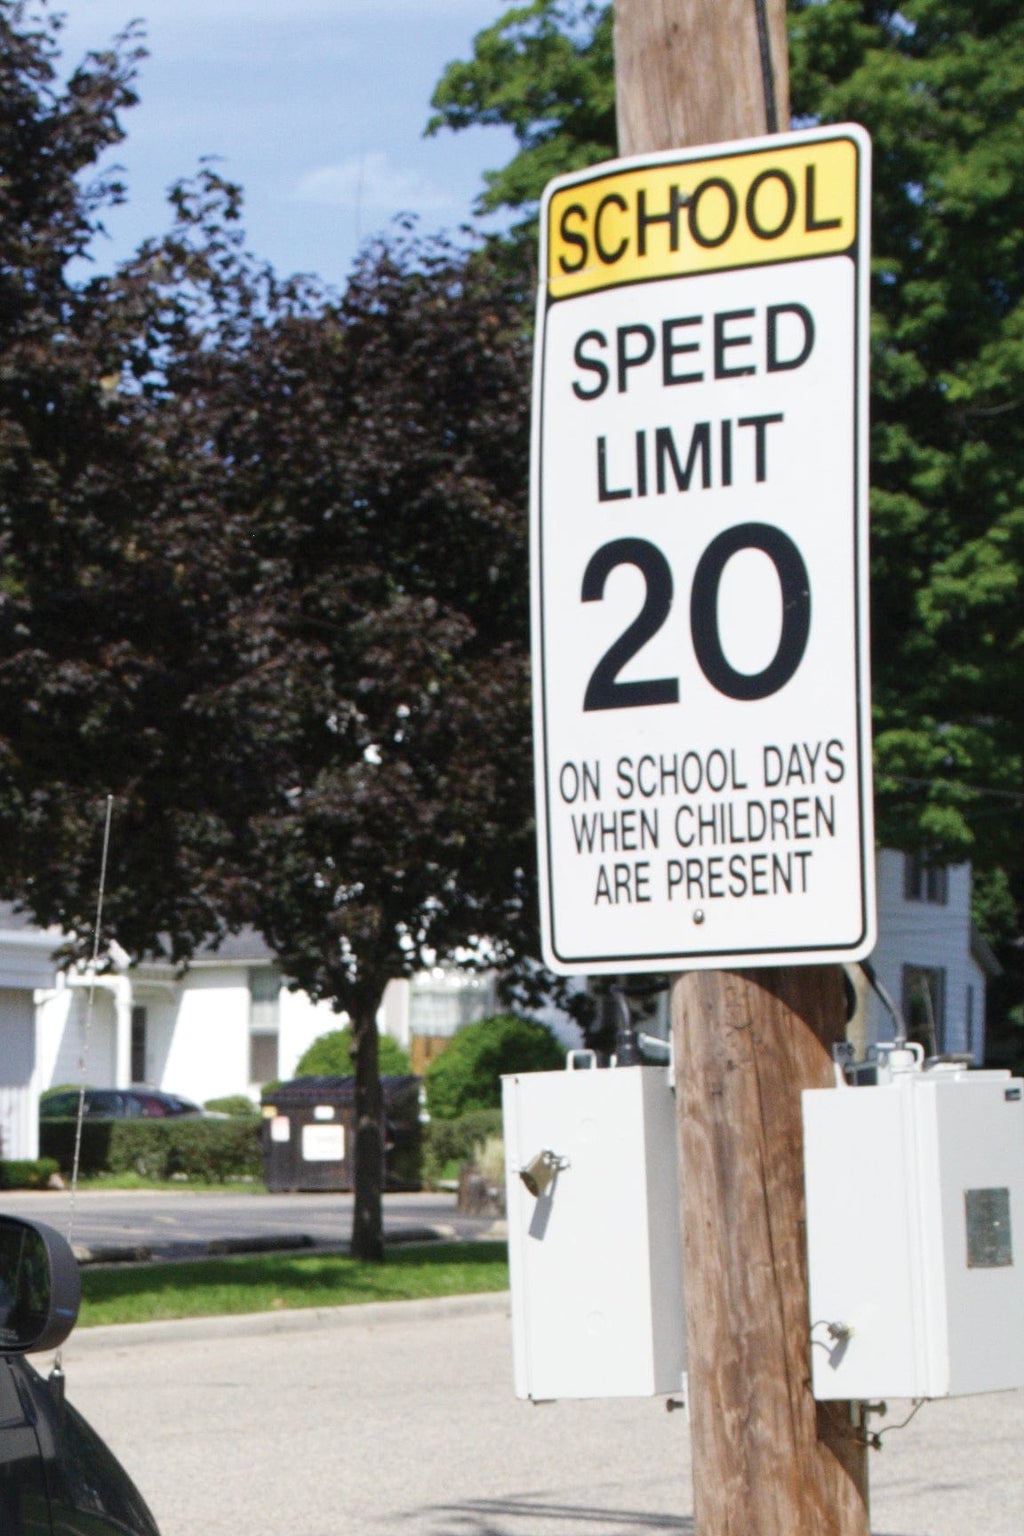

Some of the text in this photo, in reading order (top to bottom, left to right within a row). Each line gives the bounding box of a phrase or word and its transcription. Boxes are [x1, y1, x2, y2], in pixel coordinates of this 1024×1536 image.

[558, 163, 842, 274] SCHOOL
[571, 302, 815, 401] SPEED
[596, 413, 784, 503] LIMIT
[580, 522, 812, 712] 20
[559, 738, 845, 805] ON SCHOOL DAYS
[571, 795, 836, 855] WHEN CHILDREN
[594, 850, 814, 906] ARE PRESENT
